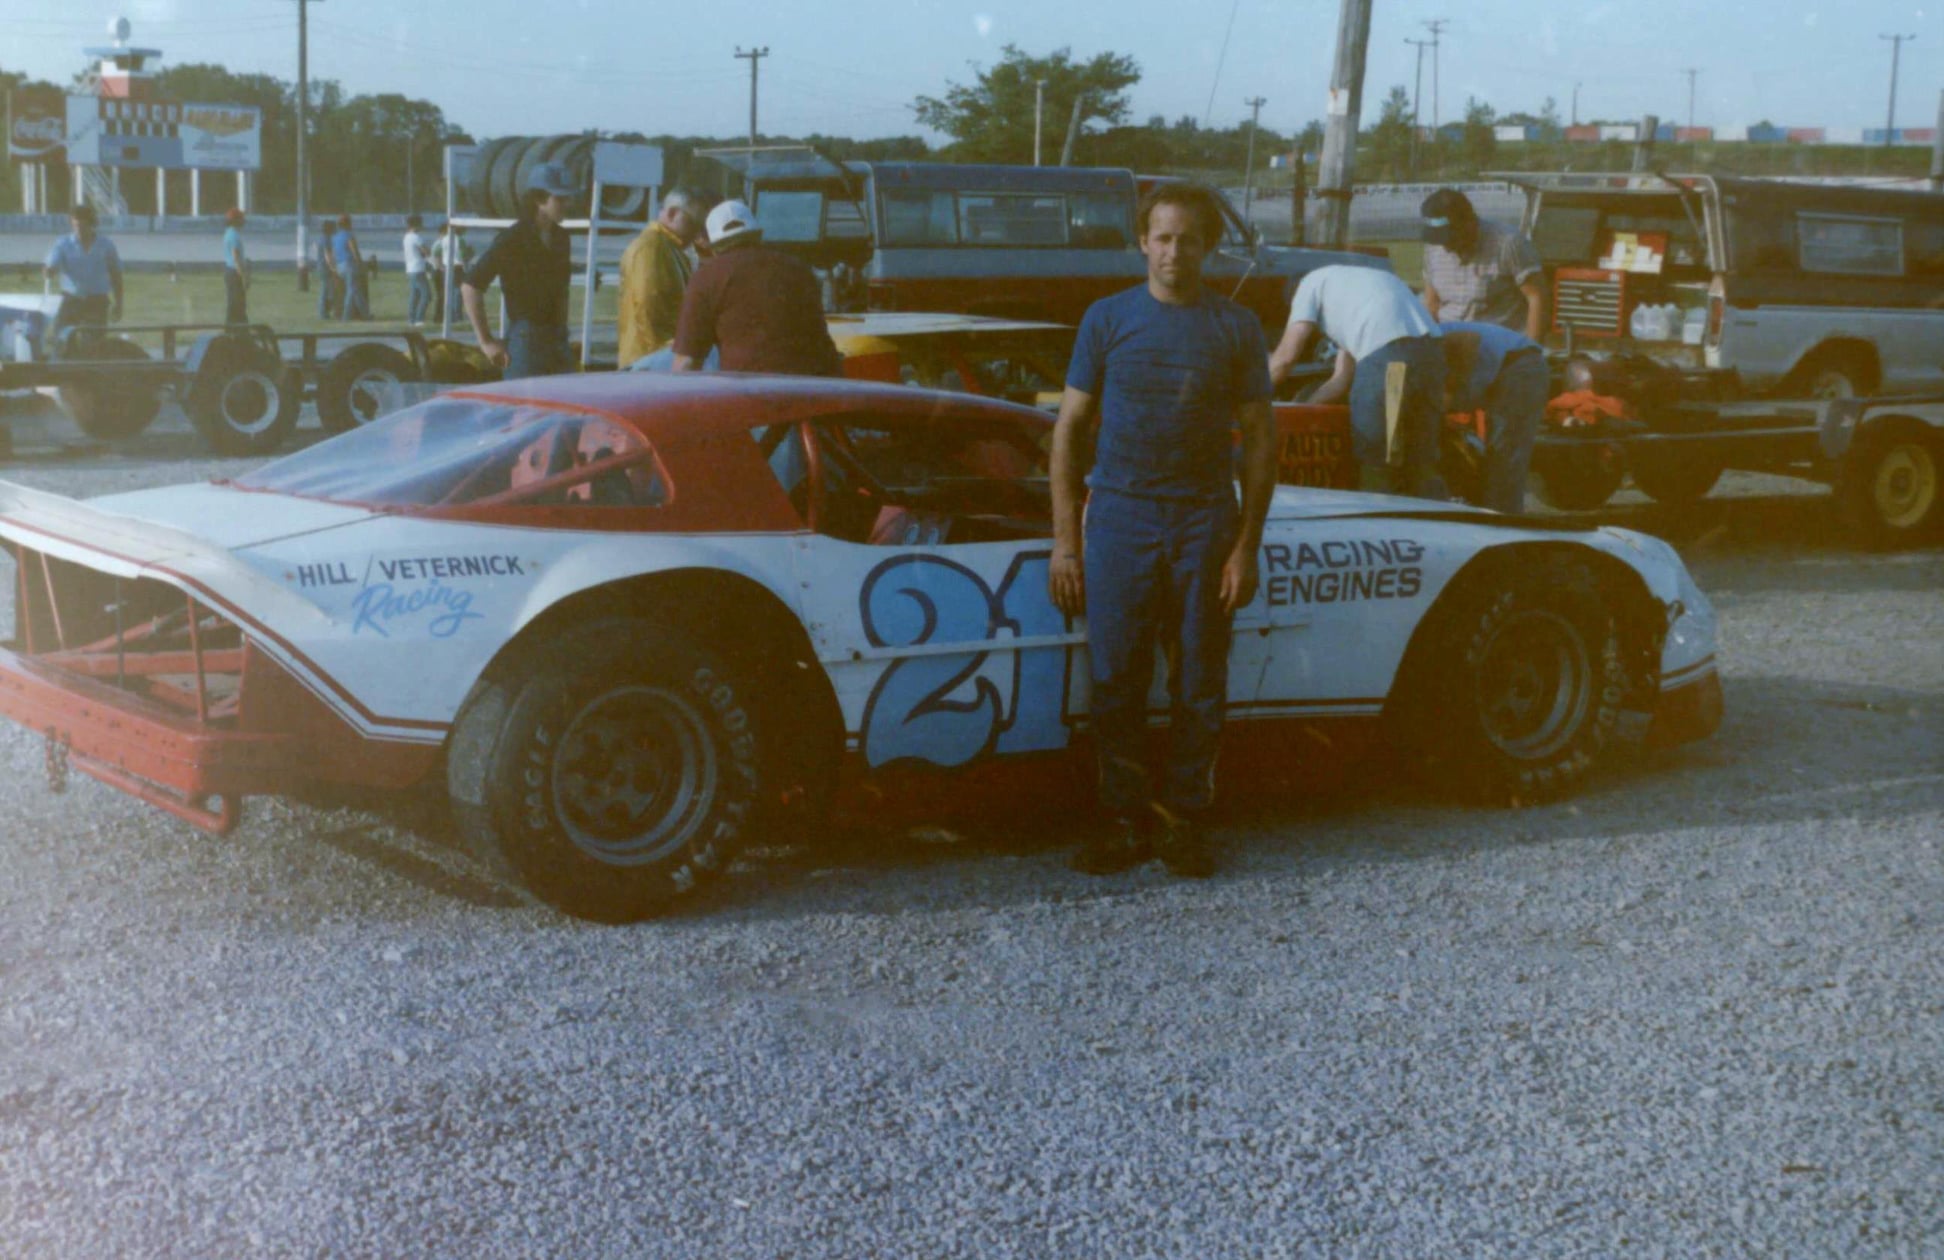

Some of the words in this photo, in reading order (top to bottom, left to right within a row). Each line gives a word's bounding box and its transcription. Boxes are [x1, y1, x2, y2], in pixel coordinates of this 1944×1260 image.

[1264, 539, 1426, 572] RACING
[352, 577, 485, 638] Racing
[1266, 567, 1422, 606] ENGINES
[859, 553, 1073, 769] 21
